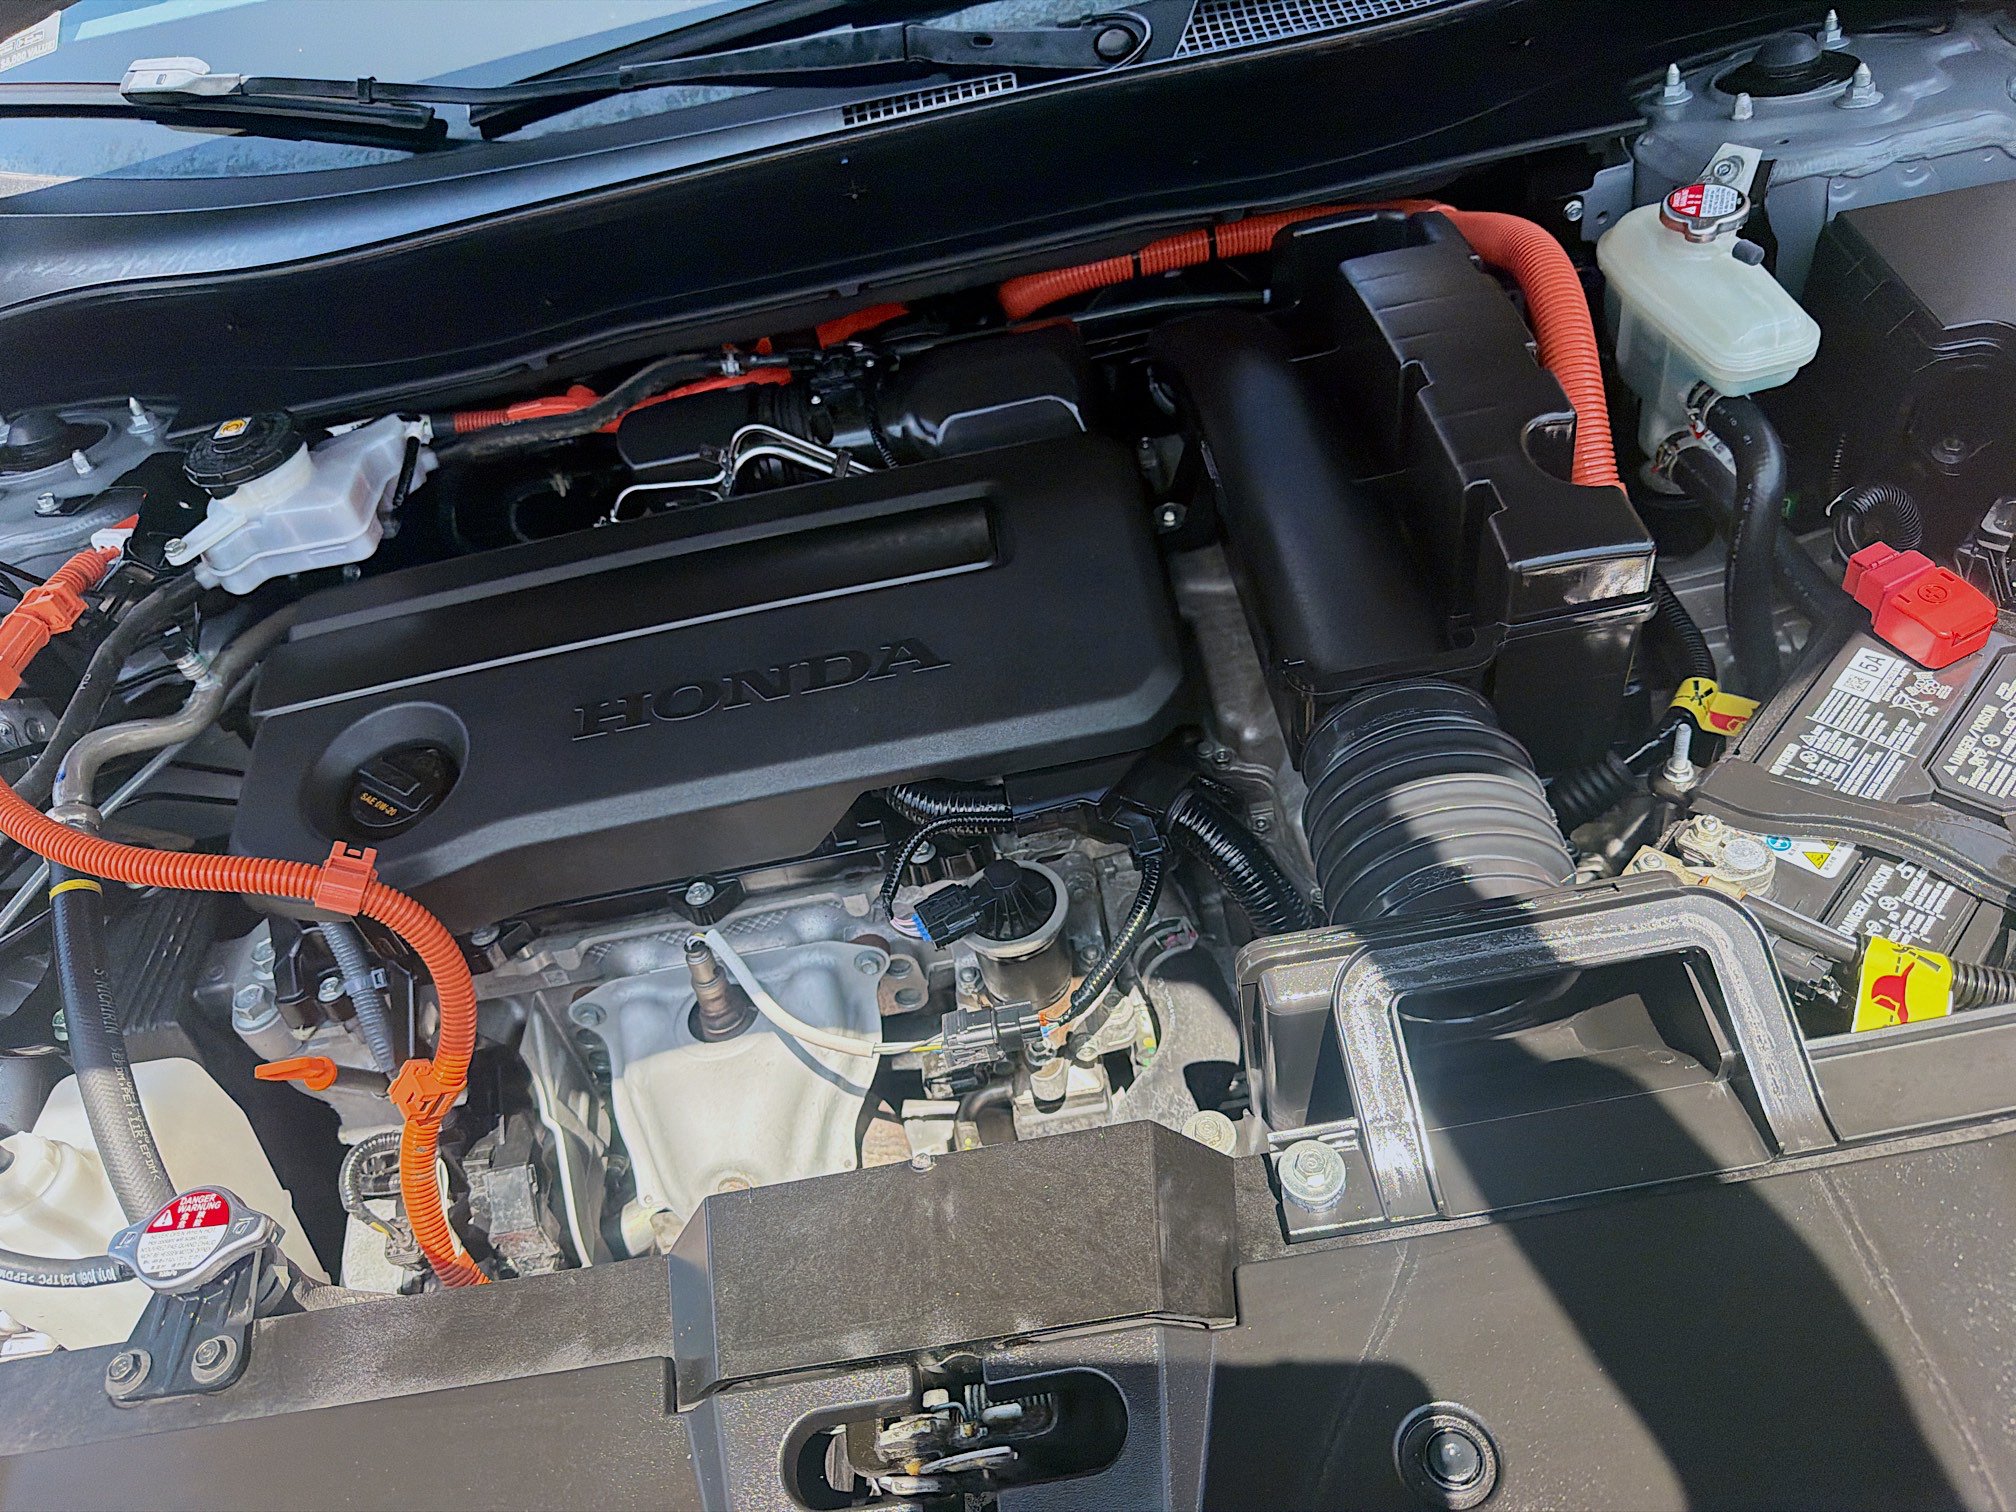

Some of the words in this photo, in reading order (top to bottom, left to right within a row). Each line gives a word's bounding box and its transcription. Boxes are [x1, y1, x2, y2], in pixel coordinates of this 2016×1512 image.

[1858, 655, 1886, 673] 5A
[572, 637, 951, 741] HONDA
[360, 792, 378, 806] SAE
[95, 980, 121, 1035] NICHIRIN
[177, 1200, 222, 1214] WARNUNG
[180, 1193, 217, 1206] DANGER
